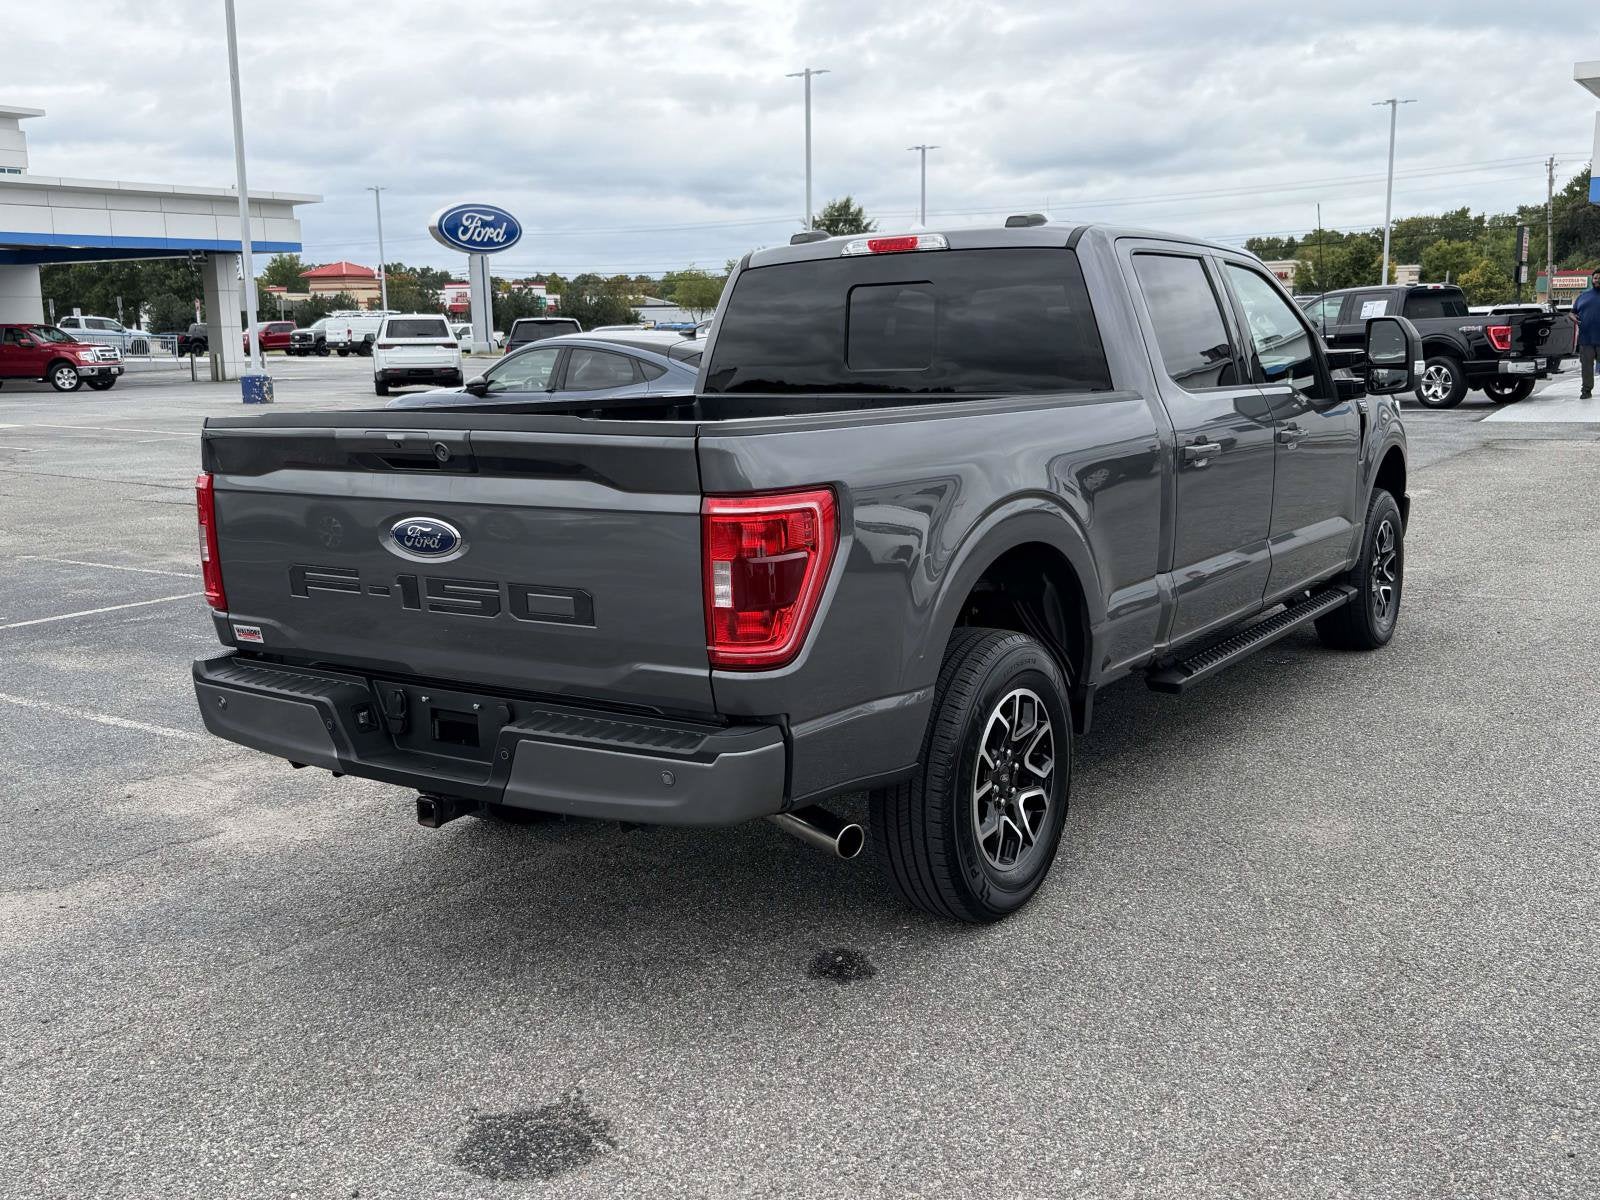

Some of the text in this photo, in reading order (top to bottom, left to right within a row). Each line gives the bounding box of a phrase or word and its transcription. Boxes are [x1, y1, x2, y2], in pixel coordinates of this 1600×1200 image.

[458, 212, 507, 243] Ford
[404, 525, 442, 549] Ford
[288, 563, 598, 629] F-150
